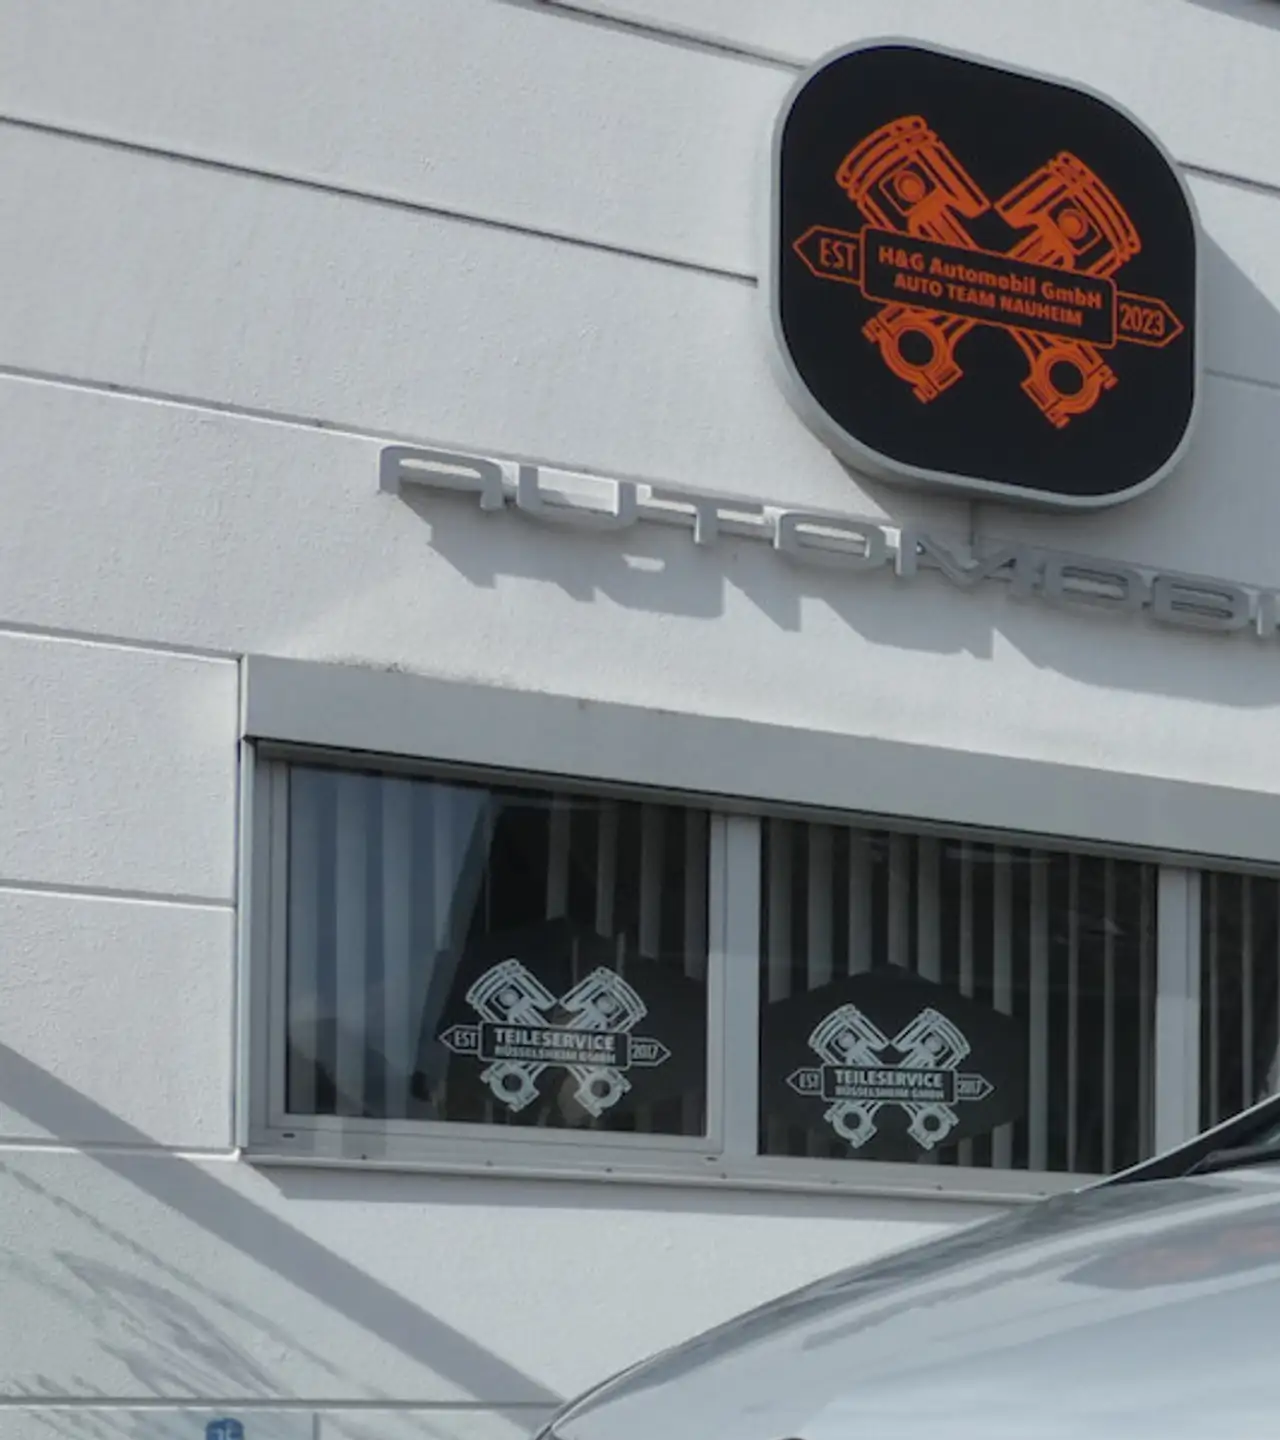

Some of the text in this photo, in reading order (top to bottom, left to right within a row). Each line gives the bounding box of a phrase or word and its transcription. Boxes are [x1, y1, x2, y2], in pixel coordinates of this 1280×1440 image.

[819, 238, 856, 273] EST
[878, 245, 1104, 310] H&G Automobil GmbH
[893, 273, 1082, 326] AUTO TEAM NAUHEIM
[1120, 304, 1165, 336] 2023
[454, 1031, 478, 1047] EST
[494, 1028, 616, 1050] TEILESERVICE
[800, 1073, 819, 1089] EST
[834, 1069, 944, 1087] TEILESERVICE
